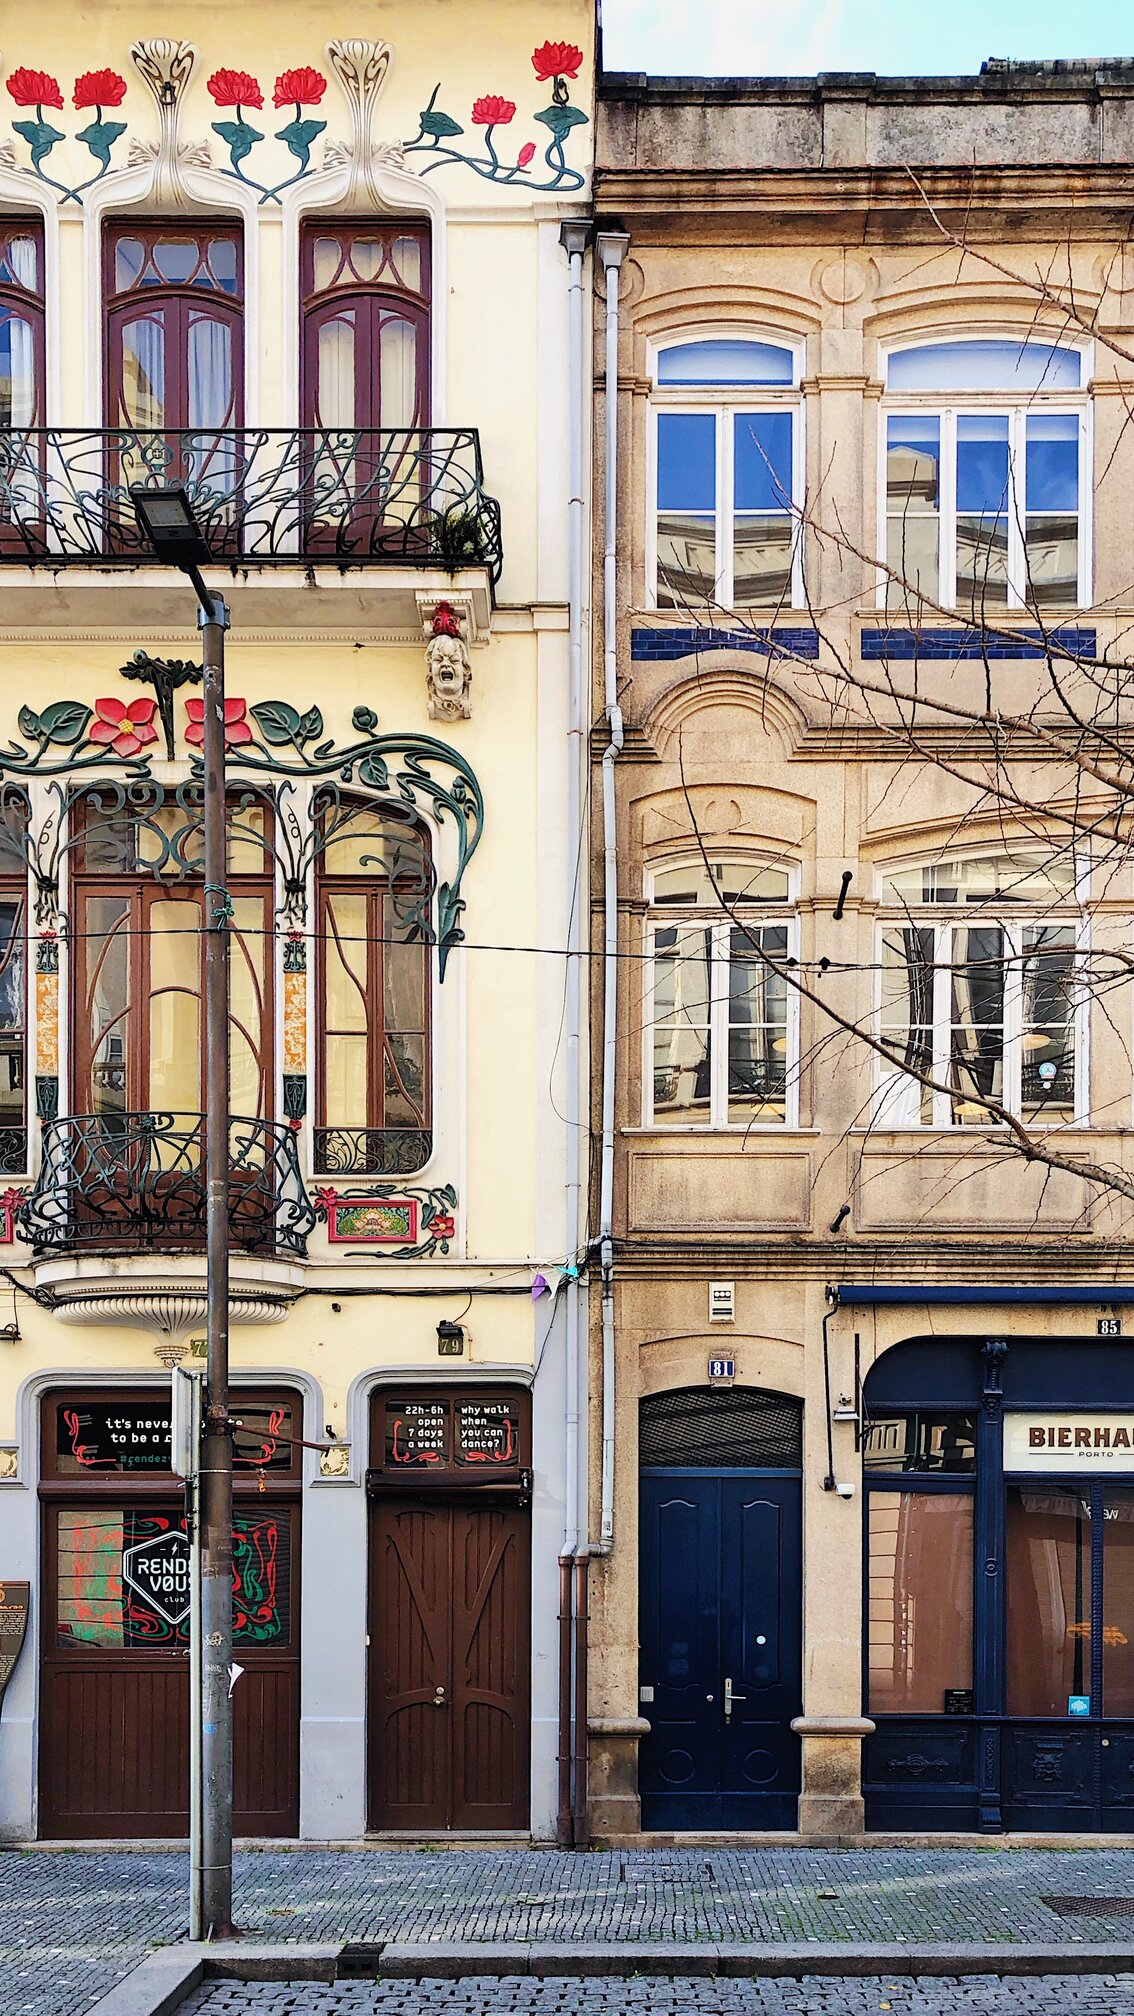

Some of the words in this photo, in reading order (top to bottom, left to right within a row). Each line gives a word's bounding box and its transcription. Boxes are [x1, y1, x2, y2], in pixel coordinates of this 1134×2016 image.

[1101, 1320, 1118, 1334] 85
[441, 1338, 460, 1353] 79
[713, 1361, 729, 1376] 81
[405, 1406, 443, 1414] 22h-6h
[461, 1406, 481, 1415] why
[484, 1405, 510, 1414] walk
[105, 1418, 132, 1429] it's
[137, 1420, 172, 1429] neve
[418, 1419, 443, 1427] open
[461, 1417, 487, 1425] when
[111, 1433, 127, 1443] to
[131, 1433, 147, 1443] be
[152, 1435, 159, 1443] a
[418, 1429, 443, 1438] days
[461, 1429, 480, 1438] you
[1029, 1427, 1134, 1448] BIERHA
[418, 1440, 443, 1448] week
[461, 1439, 499, 1448] dance?
[138, 1558, 190, 1574] REND
